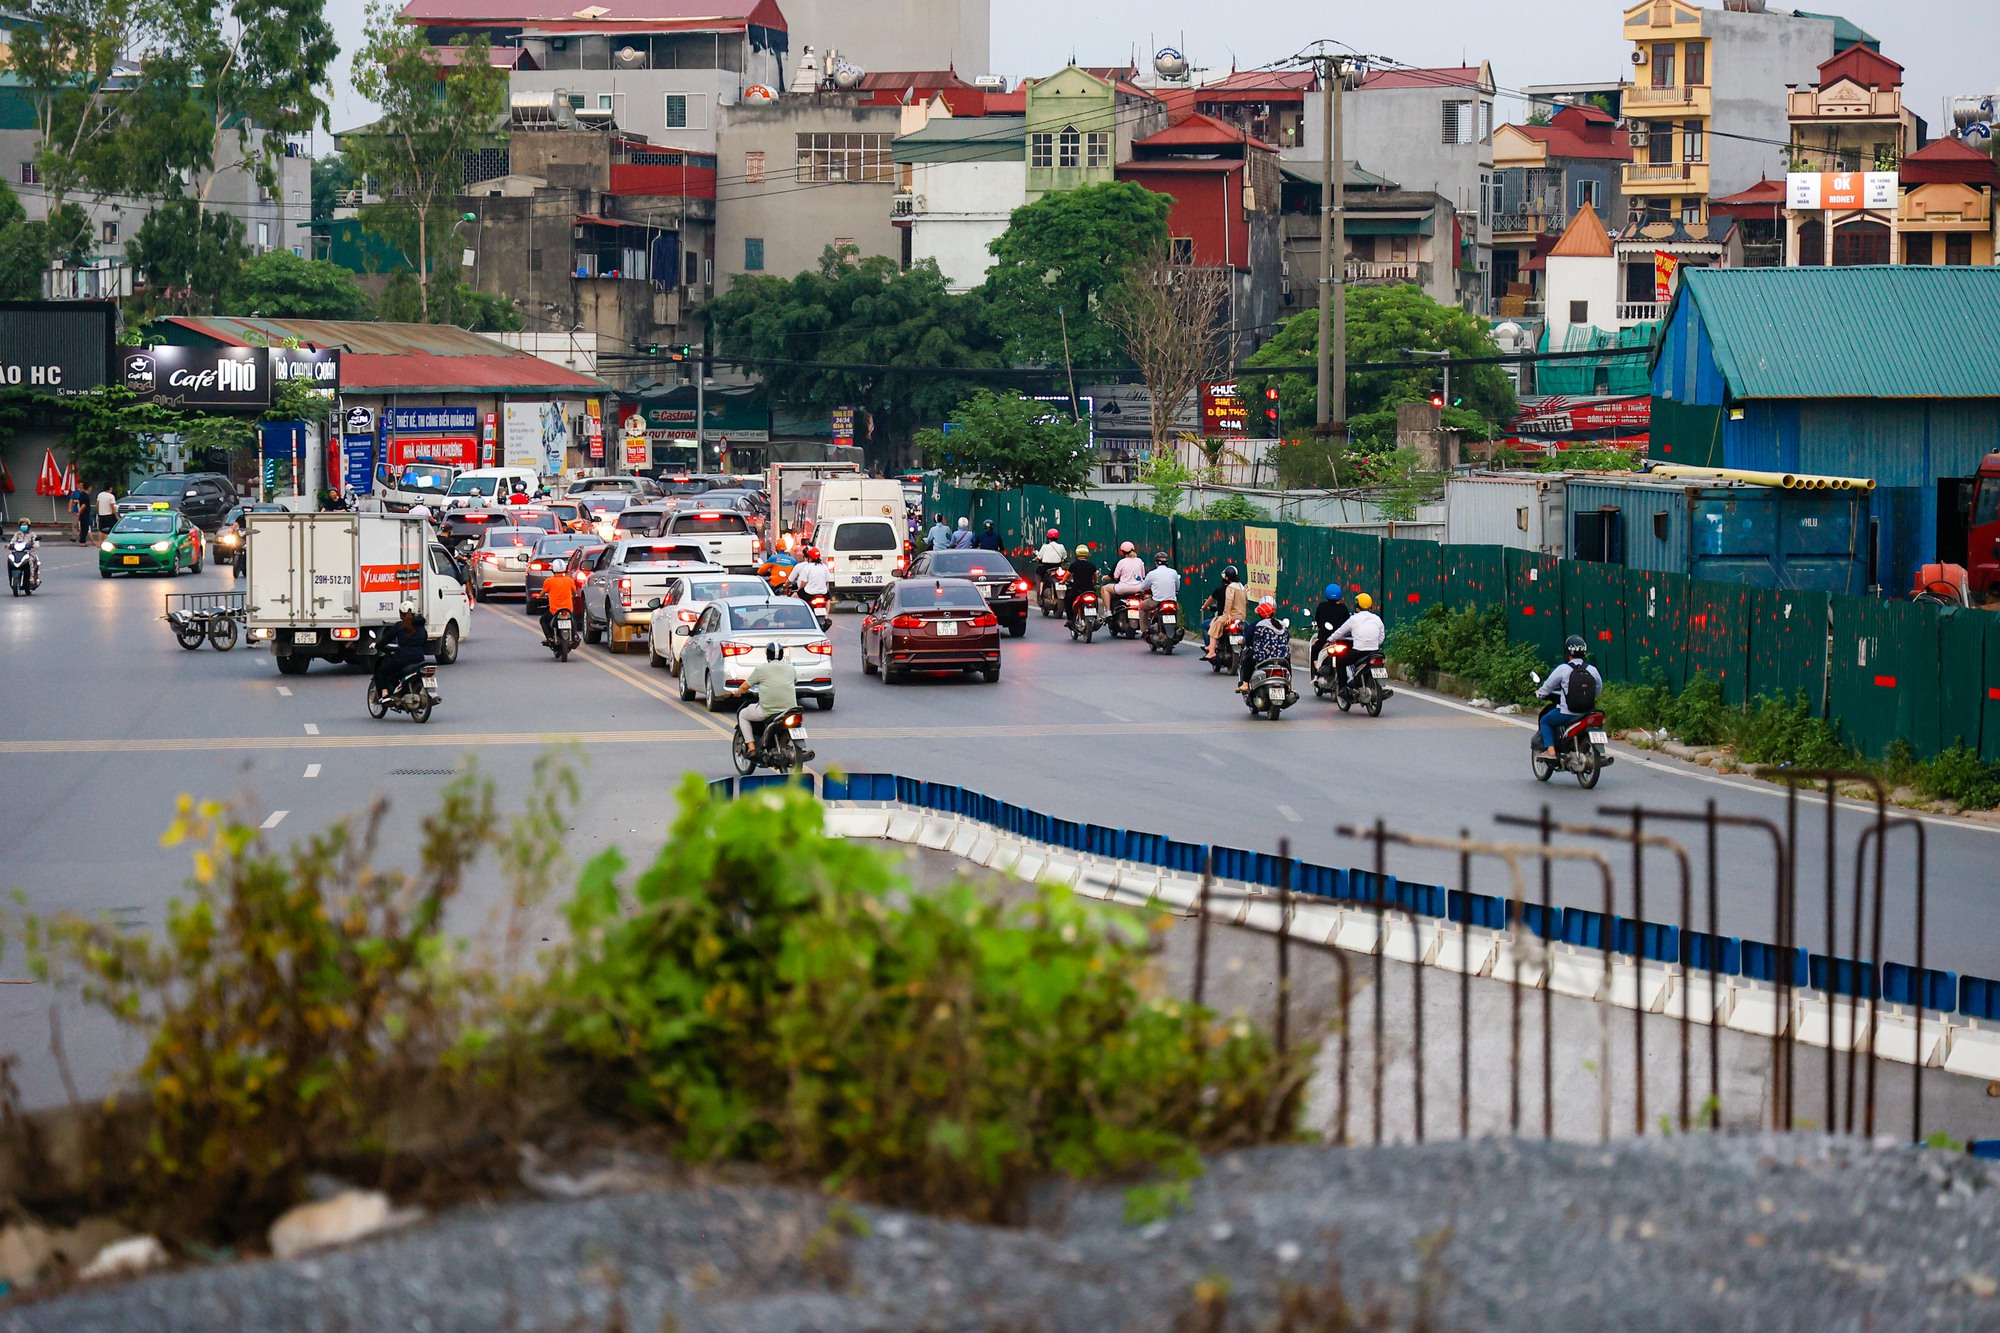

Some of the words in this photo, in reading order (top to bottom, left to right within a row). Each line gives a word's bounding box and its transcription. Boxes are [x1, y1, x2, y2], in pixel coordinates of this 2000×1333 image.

[1834, 177, 1851, 190] OK
[1829, 195, 1855, 203] MONEY
[274, 356, 288, 380] TRÀ
[315, 357, 336, 381] QUÁN
[31, 365, 62, 385] HC
[169, 369, 218, 392] Café
[218, 358, 256, 391] Phố
[396, 411, 409, 428] THIẾT
[426, 412, 438, 427] CÔNG
[439, 410, 449, 427] BIỂN
[450, 410, 465, 428] QUẢNG
[466, 412, 475, 427] CÁO
[661, 410, 696, 421] Castrol
[667, 431, 696, 439] MOTOR
[403, 442, 415, 458] NHÀ
[416, 441, 431, 457] HÀNG
[315, 576, 352, 585] 29H-512.70
[370, 572, 395, 583] LALAMOVE
[851, 575, 883, 584] 29D-421.22
